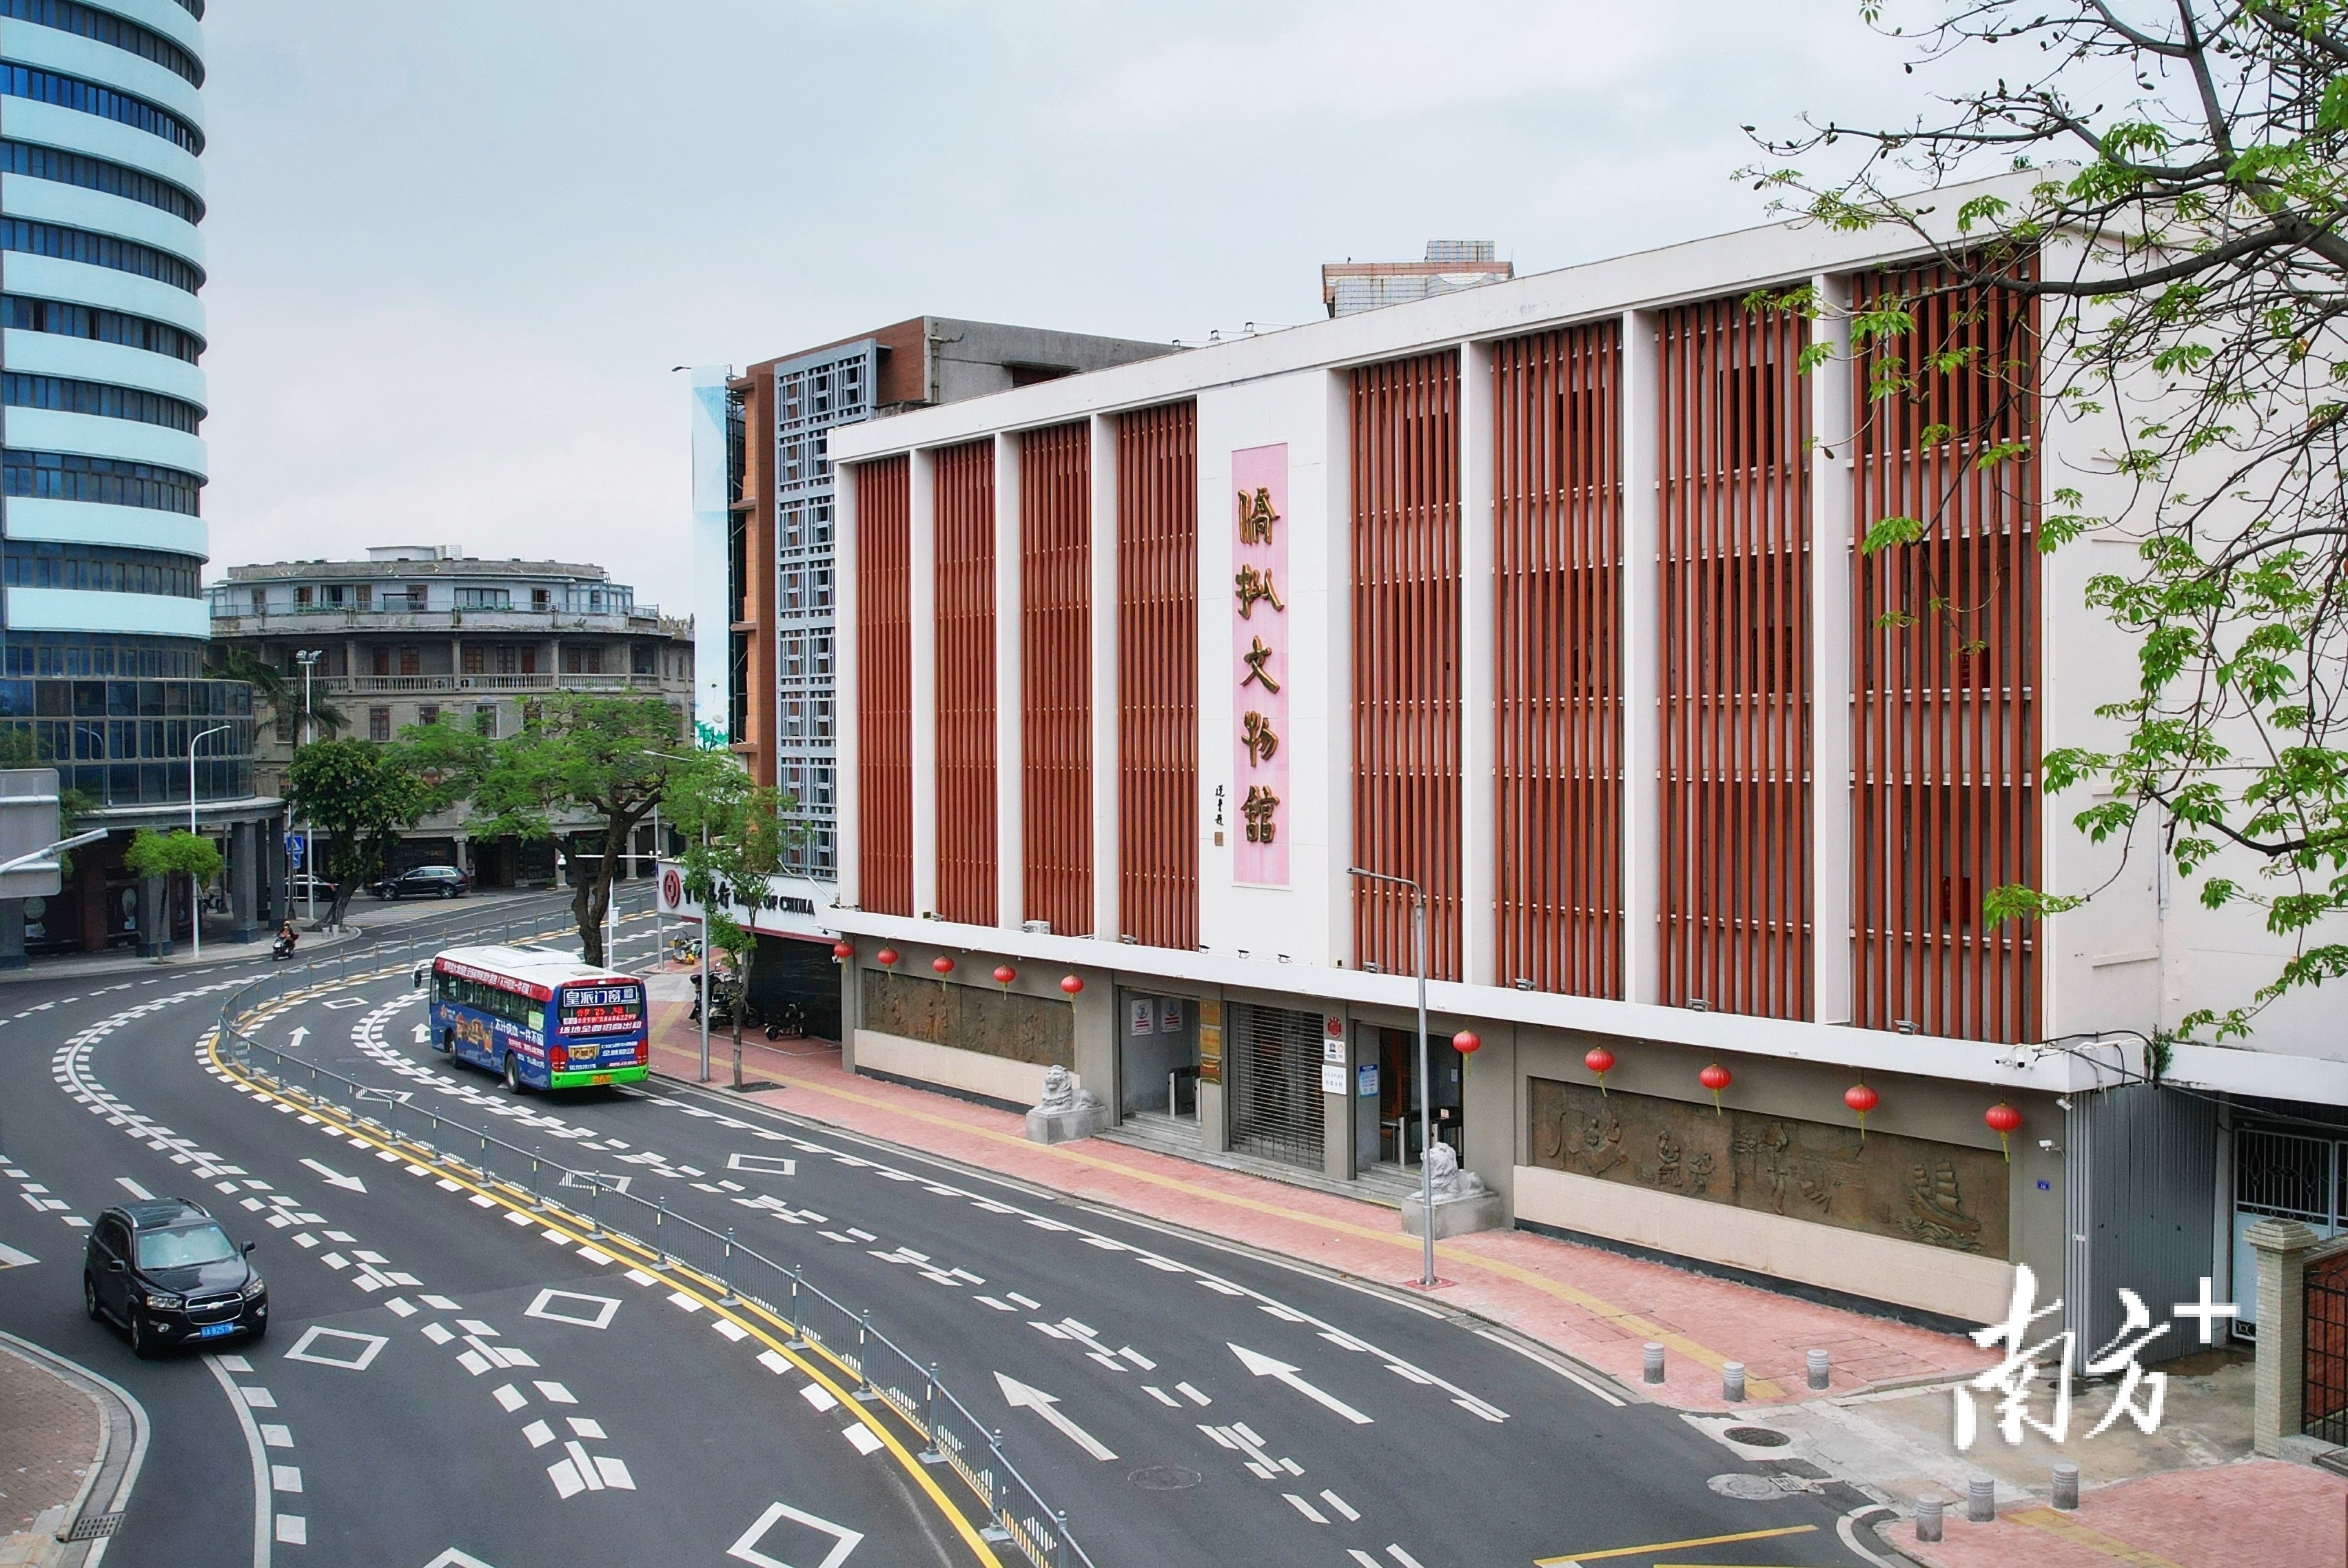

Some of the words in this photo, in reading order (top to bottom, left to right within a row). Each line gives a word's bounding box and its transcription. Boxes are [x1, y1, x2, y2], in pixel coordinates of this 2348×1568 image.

[779, 896, 815, 915] CHINA
[566, 990, 621, 1006] 皇派门窗
